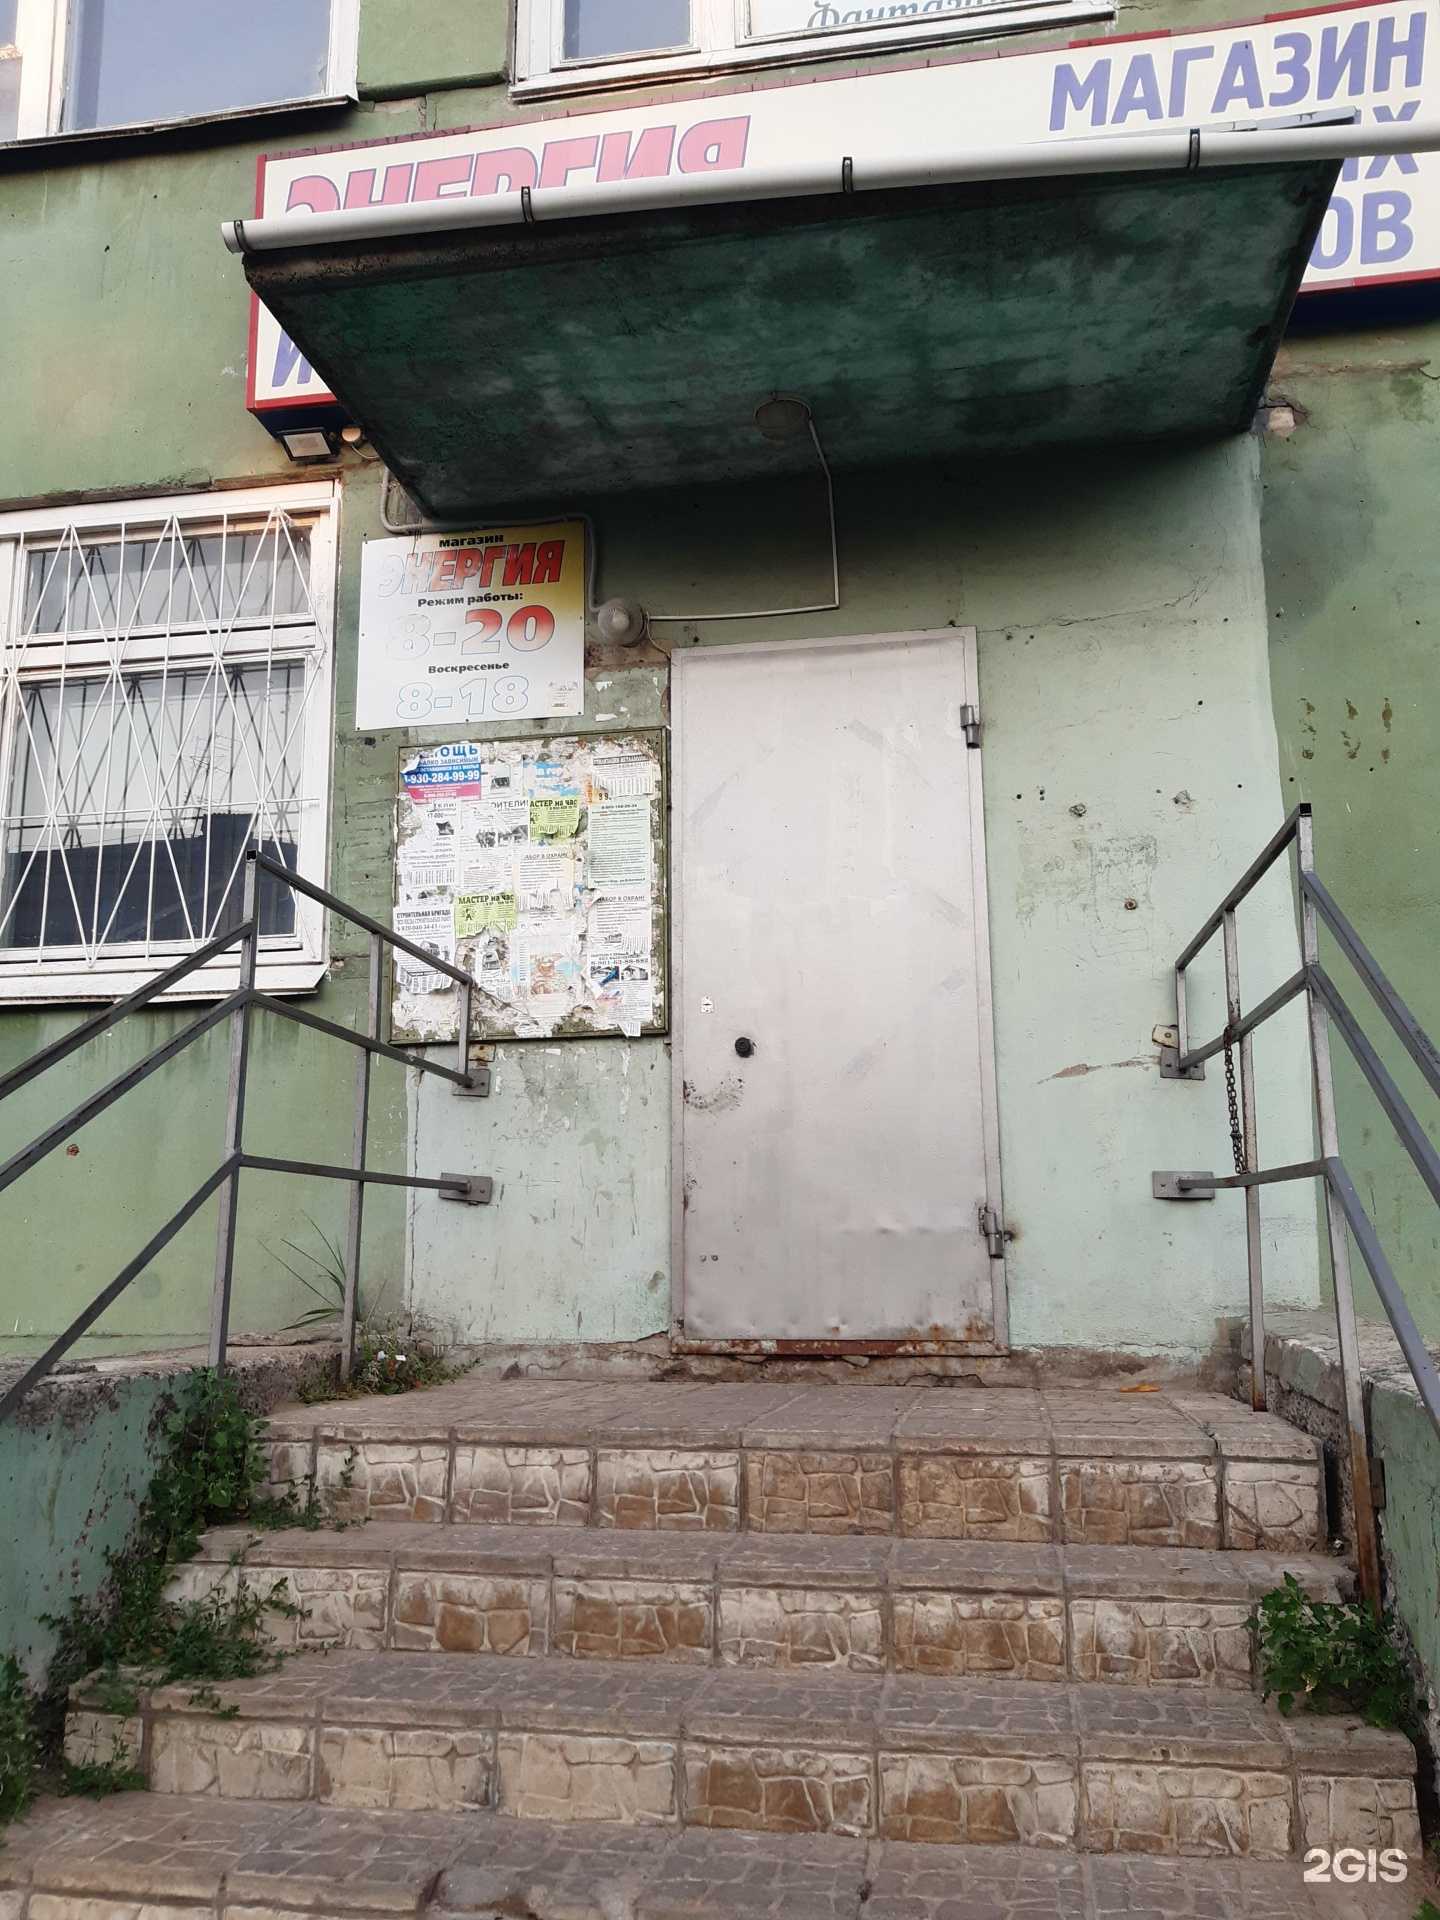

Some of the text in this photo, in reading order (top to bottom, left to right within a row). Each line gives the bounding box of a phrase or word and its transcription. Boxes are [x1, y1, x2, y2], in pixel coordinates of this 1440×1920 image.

[1048, 11, 1428, 132] МАГАЗИН
[439, 534, 504, 548] магазин
[377, 540, 565, 598] ЭНЕРГИЯ
[418, 592, 524, 608] Режим работы:
[386, 604, 556, 661] 8-20
[428, 661, 510, 674] Воскресенье
[396, 675, 530, 720] 8-18
[529, 800, 553, 808] АСТЕР
